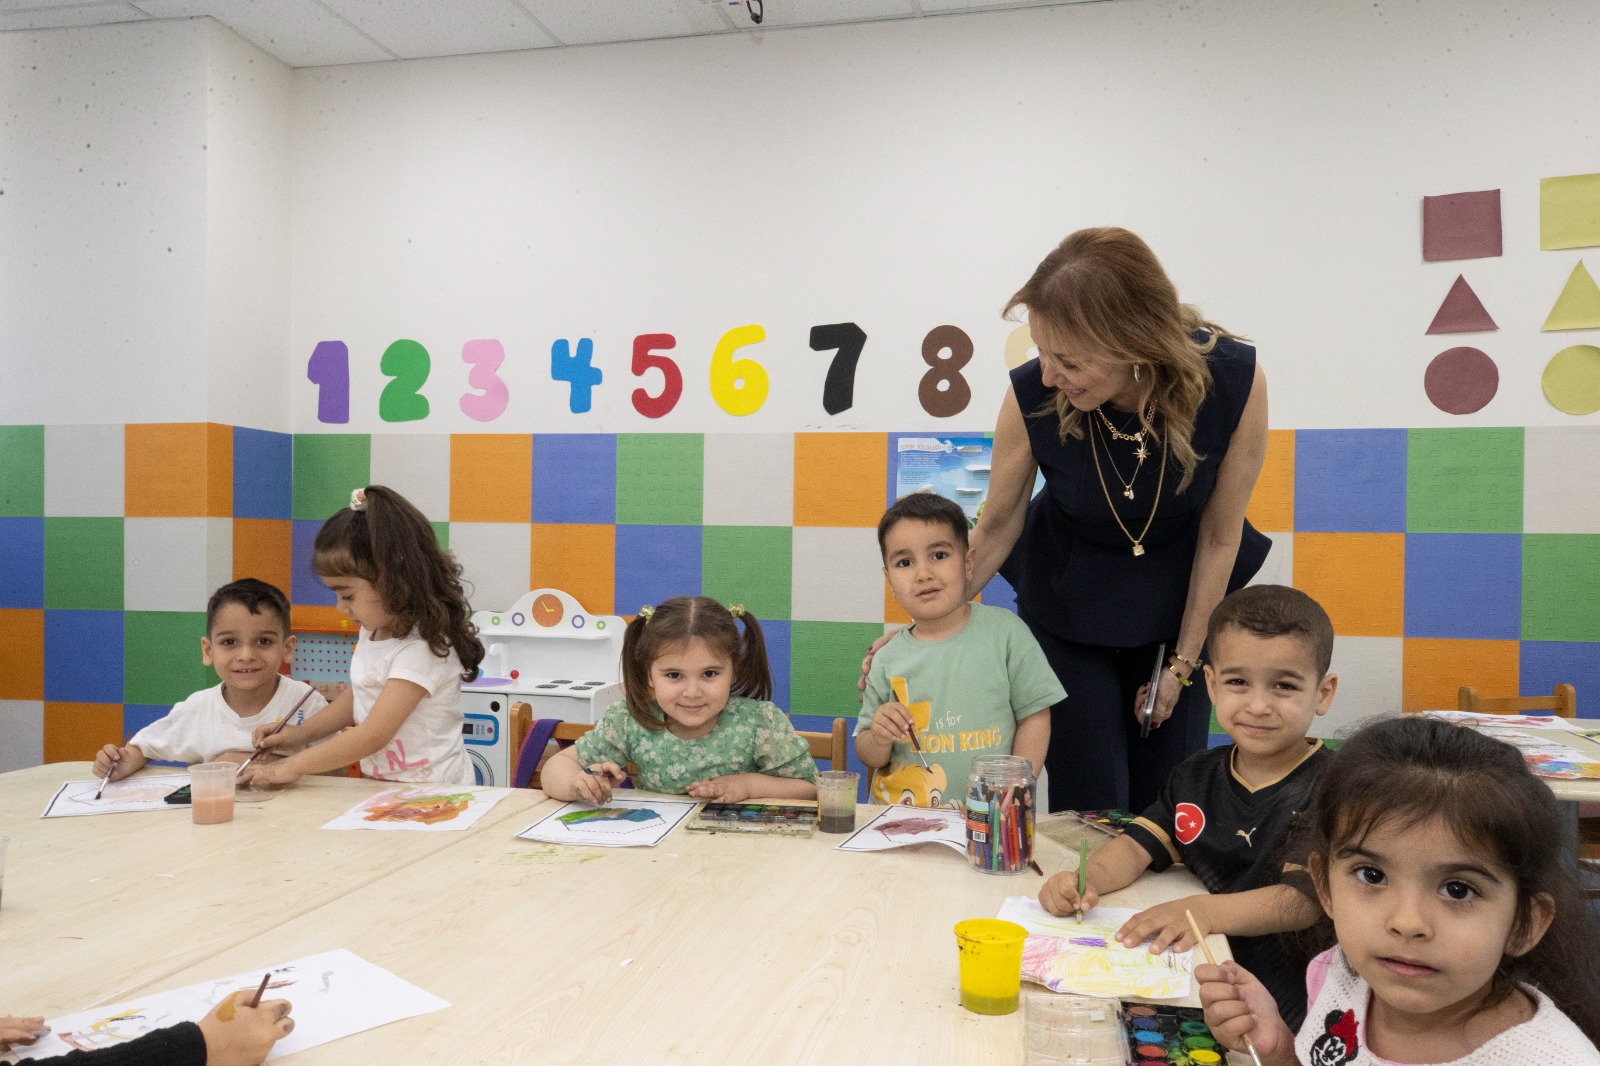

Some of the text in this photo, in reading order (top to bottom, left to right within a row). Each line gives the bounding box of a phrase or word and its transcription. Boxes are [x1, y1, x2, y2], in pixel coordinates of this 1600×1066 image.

[307, 340, 350, 424] 1
[379, 338, 431, 422] 2
[459, 339, 510, 422] 3
[551, 338, 603, 414] 4
[631, 333, 683, 419] 5
[710, 324, 769, 417] 6
[809, 322, 867, 416] 7
[918, 324, 974, 418] 8
[935, 710, 962, 730] is for
[959, 726, 1001, 751] KING
